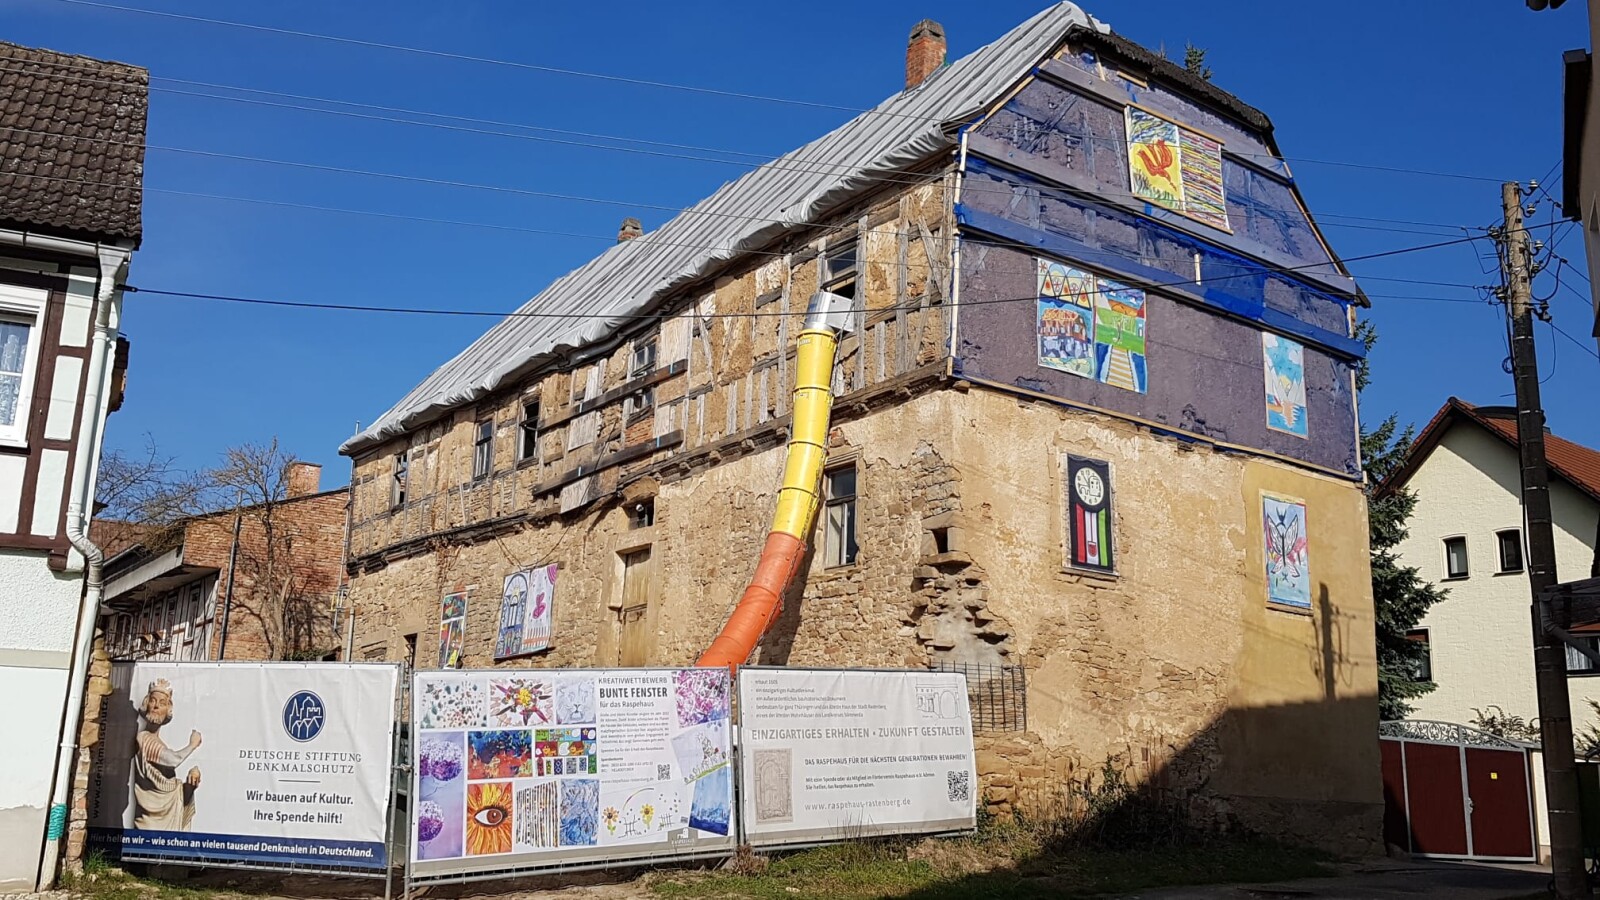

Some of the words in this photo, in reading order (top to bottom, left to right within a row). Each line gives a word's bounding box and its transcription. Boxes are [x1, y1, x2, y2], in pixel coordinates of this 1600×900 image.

[600, 688, 628, 698] BUNTE
[631, 687, 668, 698] FENSTER
[752, 729, 822, 740] EINZIGARTIGES
[826, 728, 869, 738] ERHALTEN
[879, 727, 918, 737] ZUKUNFT
[922, 726, 965, 736] GESTALTEN
[93, 697, 109, 818] www.denkmalschutz.
[239, 750, 300, 760] DEUTSCHE
[305, 752, 362, 762] STIFTUNG
[248, 762, 355, 774] DENKMALSCHUTZ
[246, 790, 263, 801] Wir
[265, 791, 296, 803] bauen
[300, 793, 317, 803] auf
[319, 793, 353, 804] Kultur.
[805, 798, 911, 811] www.raspehaus-rastenberg.de
[254, 810, 273, 821] Ihre
[276, 811, 314, 824] Spende
[317, 812, 342, 824] hilft!
[106, 834, 130, 844] helfen
[132, 835, 144, 844] wir
[151, 836, 166, 845] wie
[167, 837, 189, 847] schon
[190, 839, 200, 848] an
[202, 838, 225, 849] vielen
[226, 840, 260, 851] tausend
[261, 843, 307, 854] Denkmalen
[309, 845, 317, 855] in
[318, 846, 374, 857] Deutschland.
